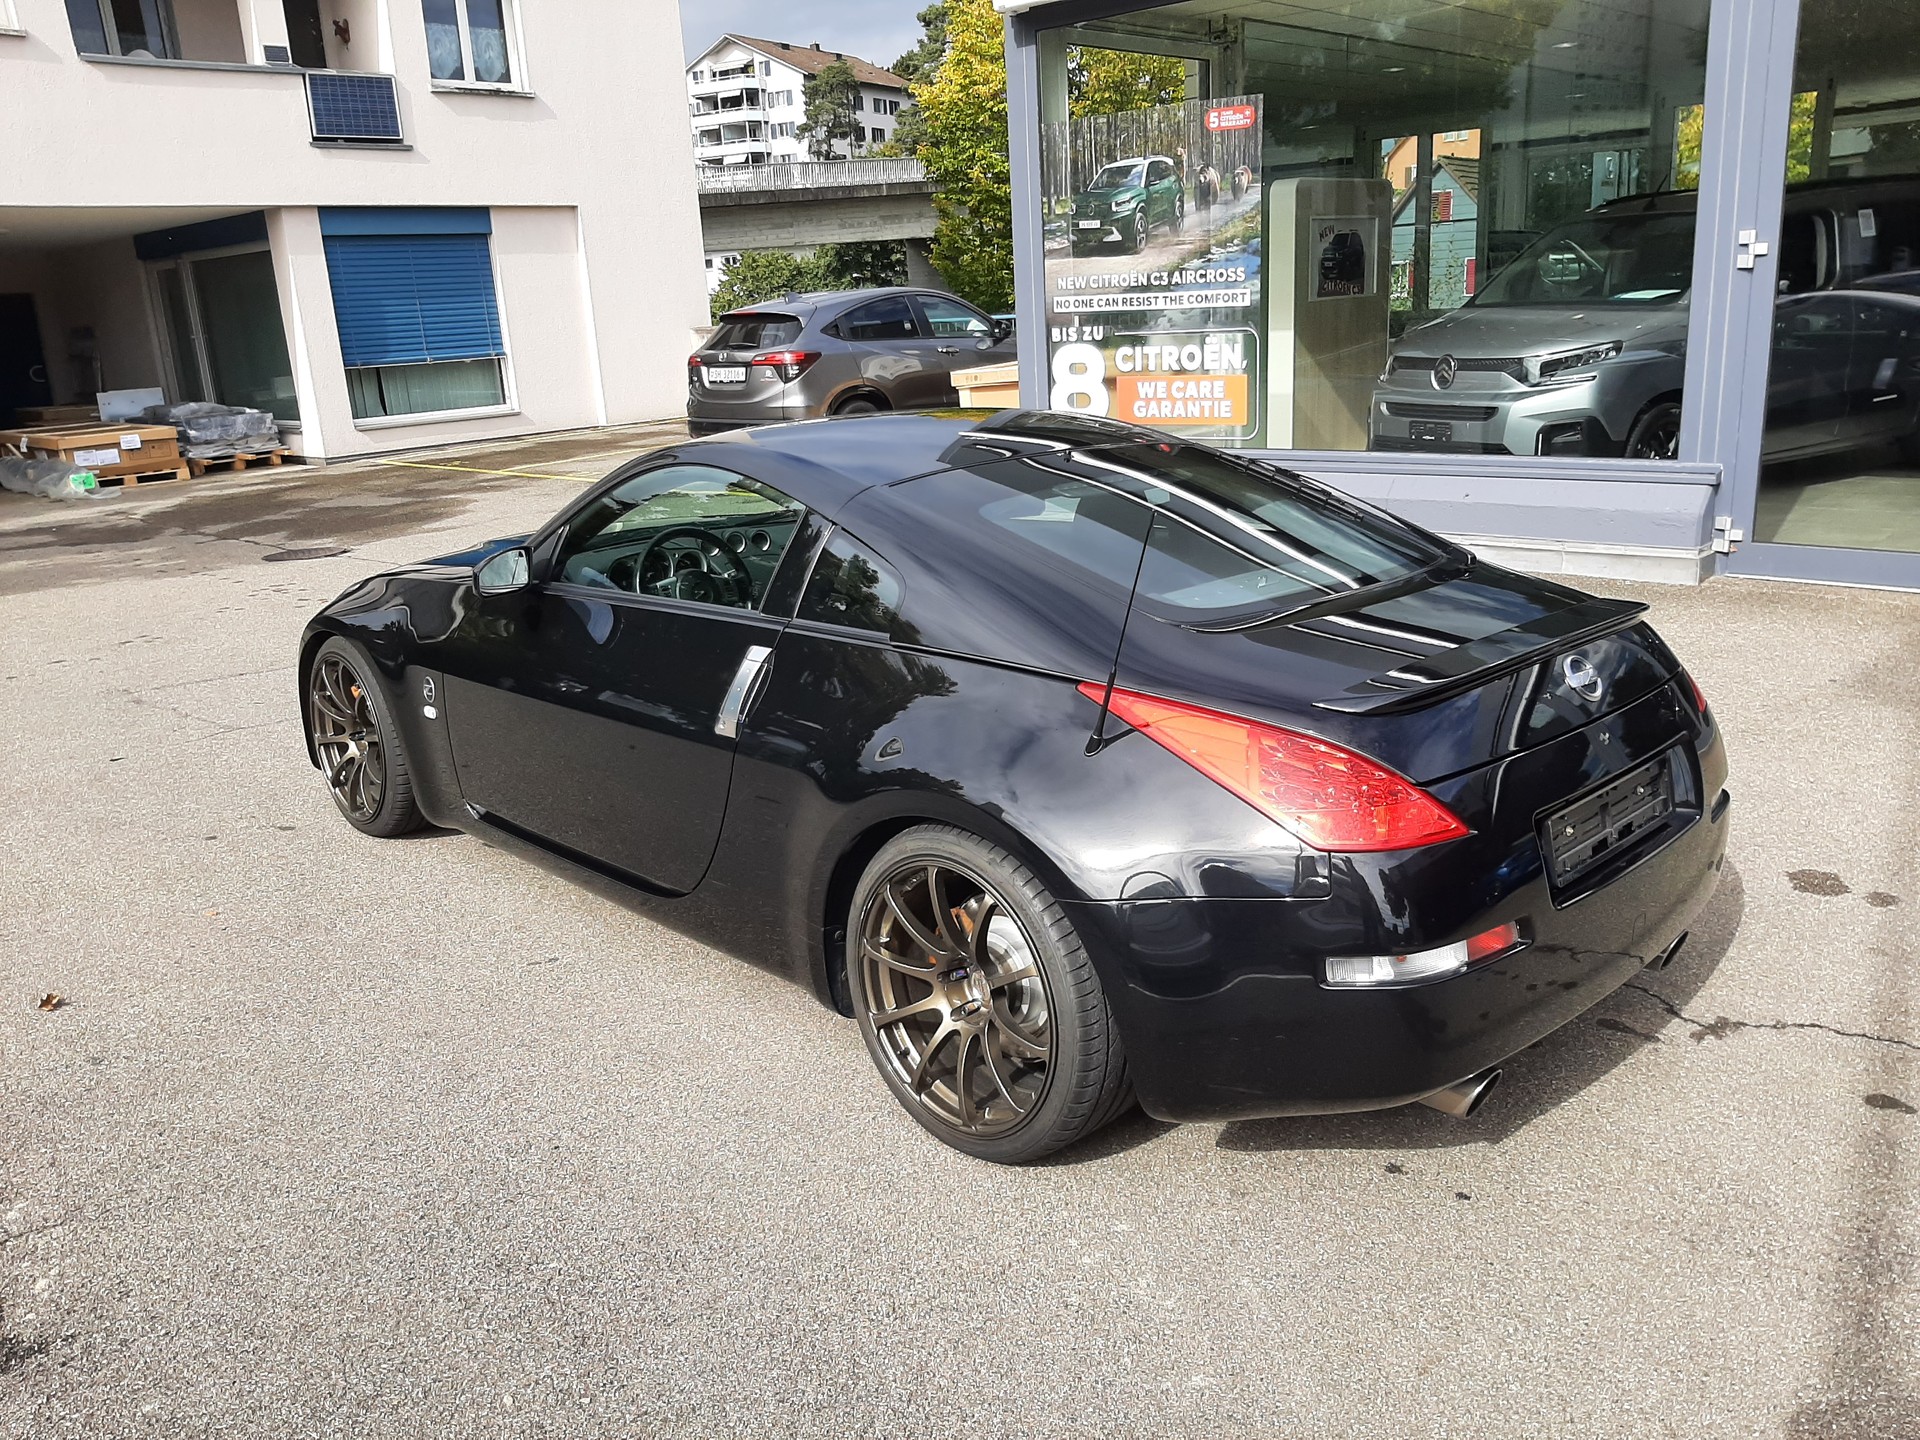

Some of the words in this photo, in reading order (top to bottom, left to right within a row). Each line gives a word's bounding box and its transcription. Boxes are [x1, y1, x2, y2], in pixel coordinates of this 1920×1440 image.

[1209, 111, 1219, 128] 5
[1057, 276, 1086, 290] NEW
[1089, 271, 1148, 288] CITROËN
[1150, 271, 1169, 286] C3
[1171, 267, 1245, 285] AIRCROSS
[1056, 300, 1071, 310] NO
[1073, 298, 1094, 309] ONE
[1097, 297, 1119, 308] CAN
[1121, 296, 1159, 307] RESIST
[1162, 294, 1184, 305] THE
[1187, 292, 1247, 305] COMFORT
[1051, 327, 1078, 343] BIS
[1082, 325, 1104, 341] ZU
[1050, 343, 1110, 417] 8
[1136, 380, 1168, 399] WE
[1171, 380, 1225, 399] CARE
[1133, 400, 1232, 418] GARANTIE
